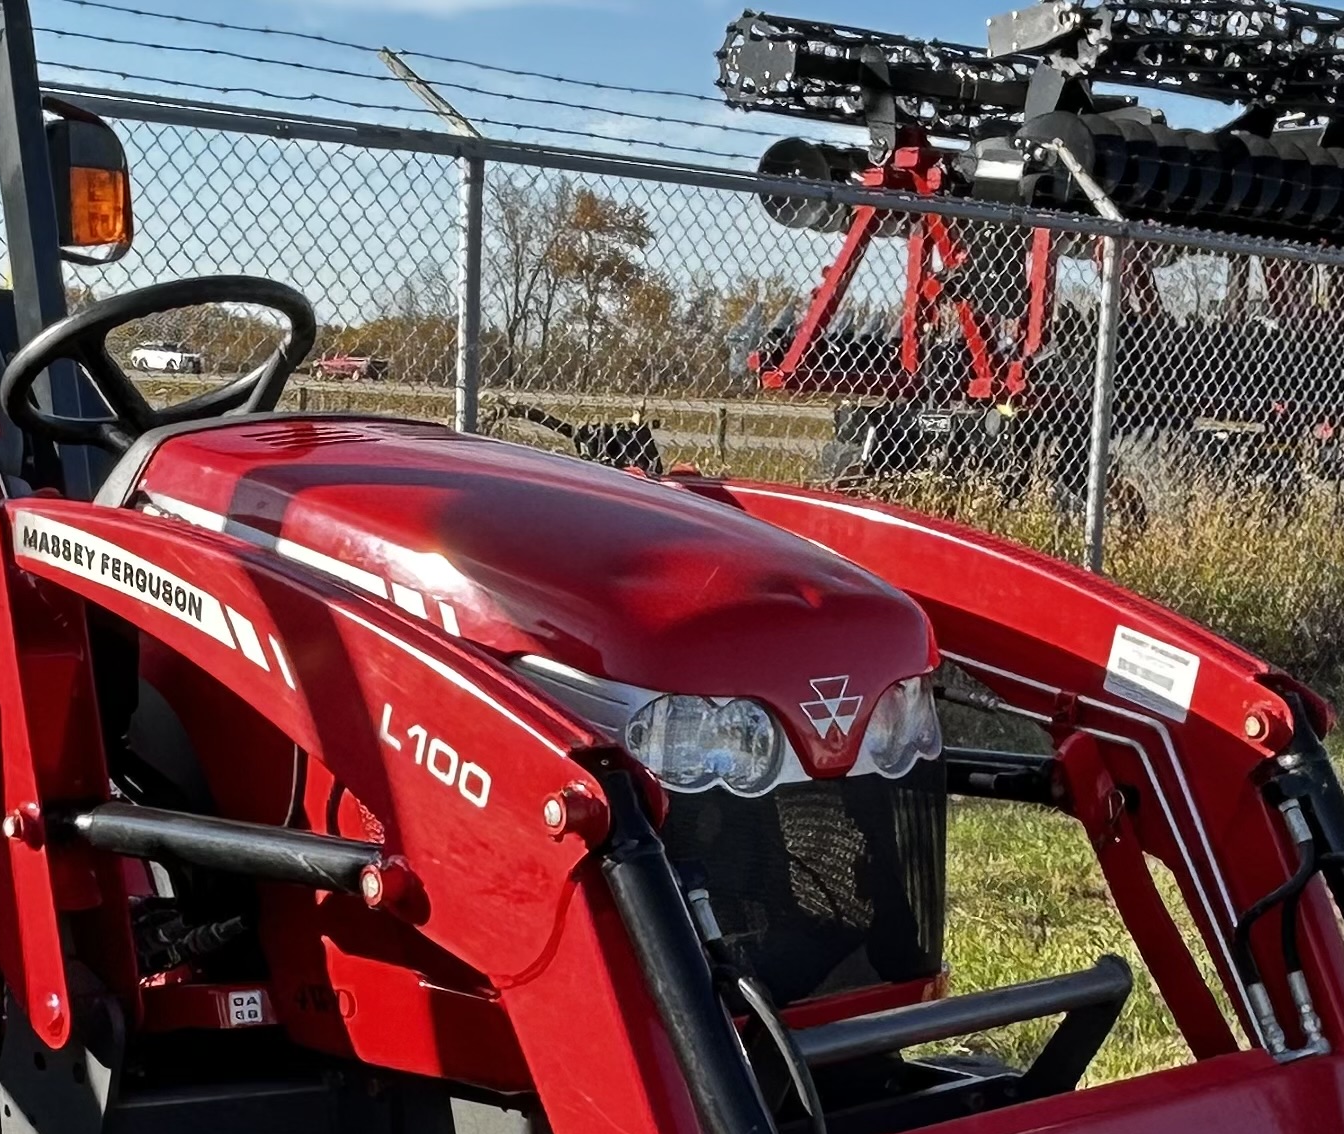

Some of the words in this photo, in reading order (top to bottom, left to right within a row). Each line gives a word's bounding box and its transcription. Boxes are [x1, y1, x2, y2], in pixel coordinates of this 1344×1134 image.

[22, 525, 96, 570] MASSEY
[100, 552, 204, 622] FERGUSON
[378, 702, 492, 808] L100
